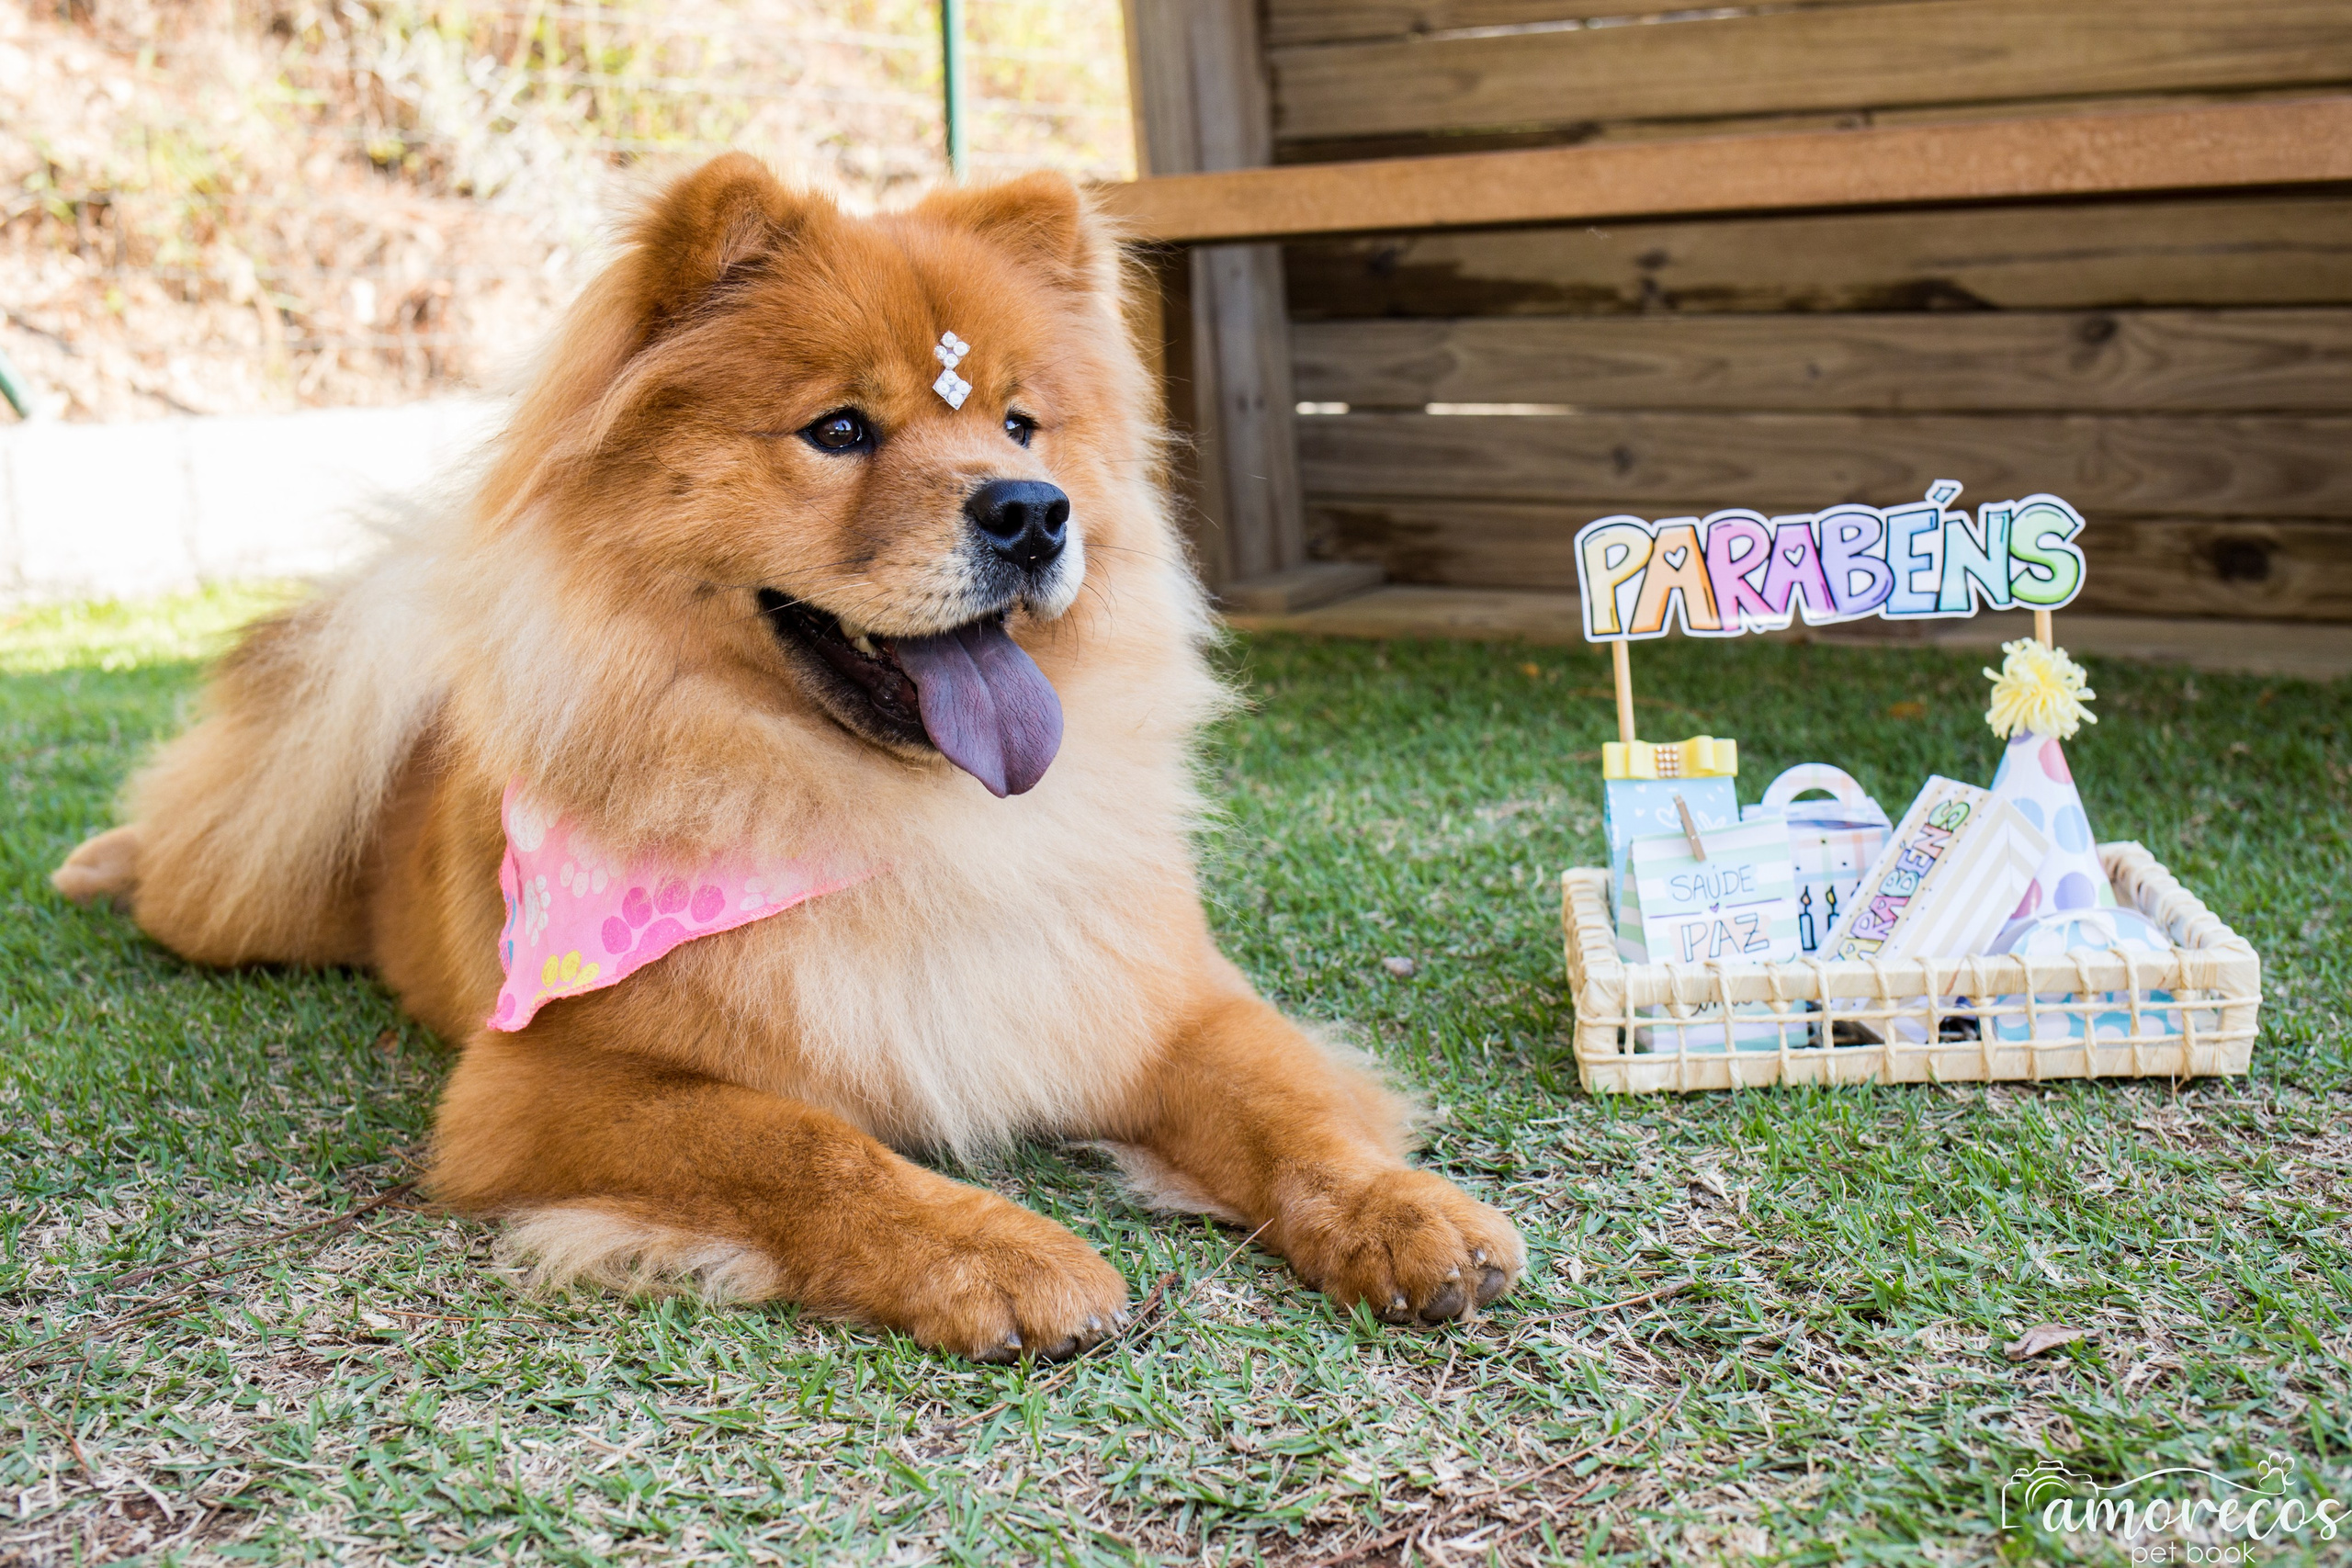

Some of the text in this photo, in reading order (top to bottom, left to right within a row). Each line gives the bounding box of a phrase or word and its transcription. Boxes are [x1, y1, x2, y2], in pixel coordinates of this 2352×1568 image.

[1578, 483, 2082, 637] PARABÉNS
[1670, 864, 1755, 902] SAÚDE
[1828, 799, 1971, 961] ARABÉNS
[1681, 913, 1770, 963] PAZ
